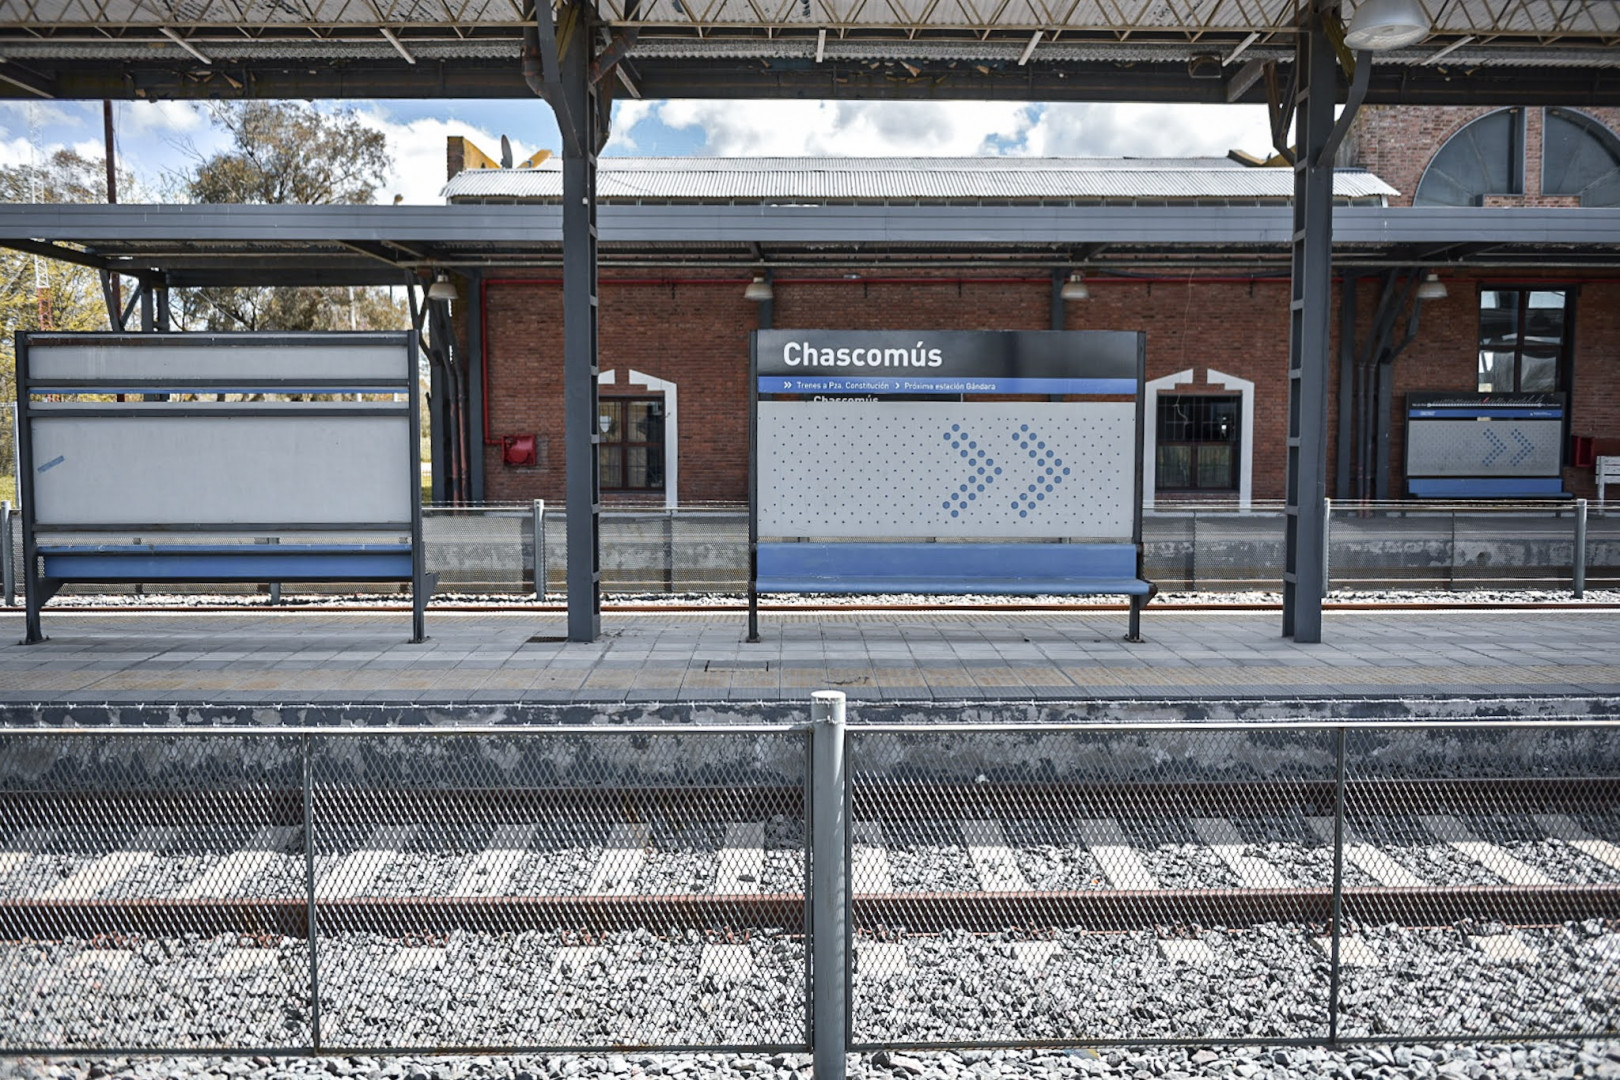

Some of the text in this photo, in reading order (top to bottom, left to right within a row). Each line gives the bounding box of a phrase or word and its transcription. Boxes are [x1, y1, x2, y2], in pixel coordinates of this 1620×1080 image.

[784, 341, 942, 367] Chascomús
[796, 381, 821, 389] Trenes
[845, 381, 889, 389] Constitución
[905, 382, 934, 390] Próxima
[935, 382, 964, 390] estación
[966, 382, 996, 390] Gándara
